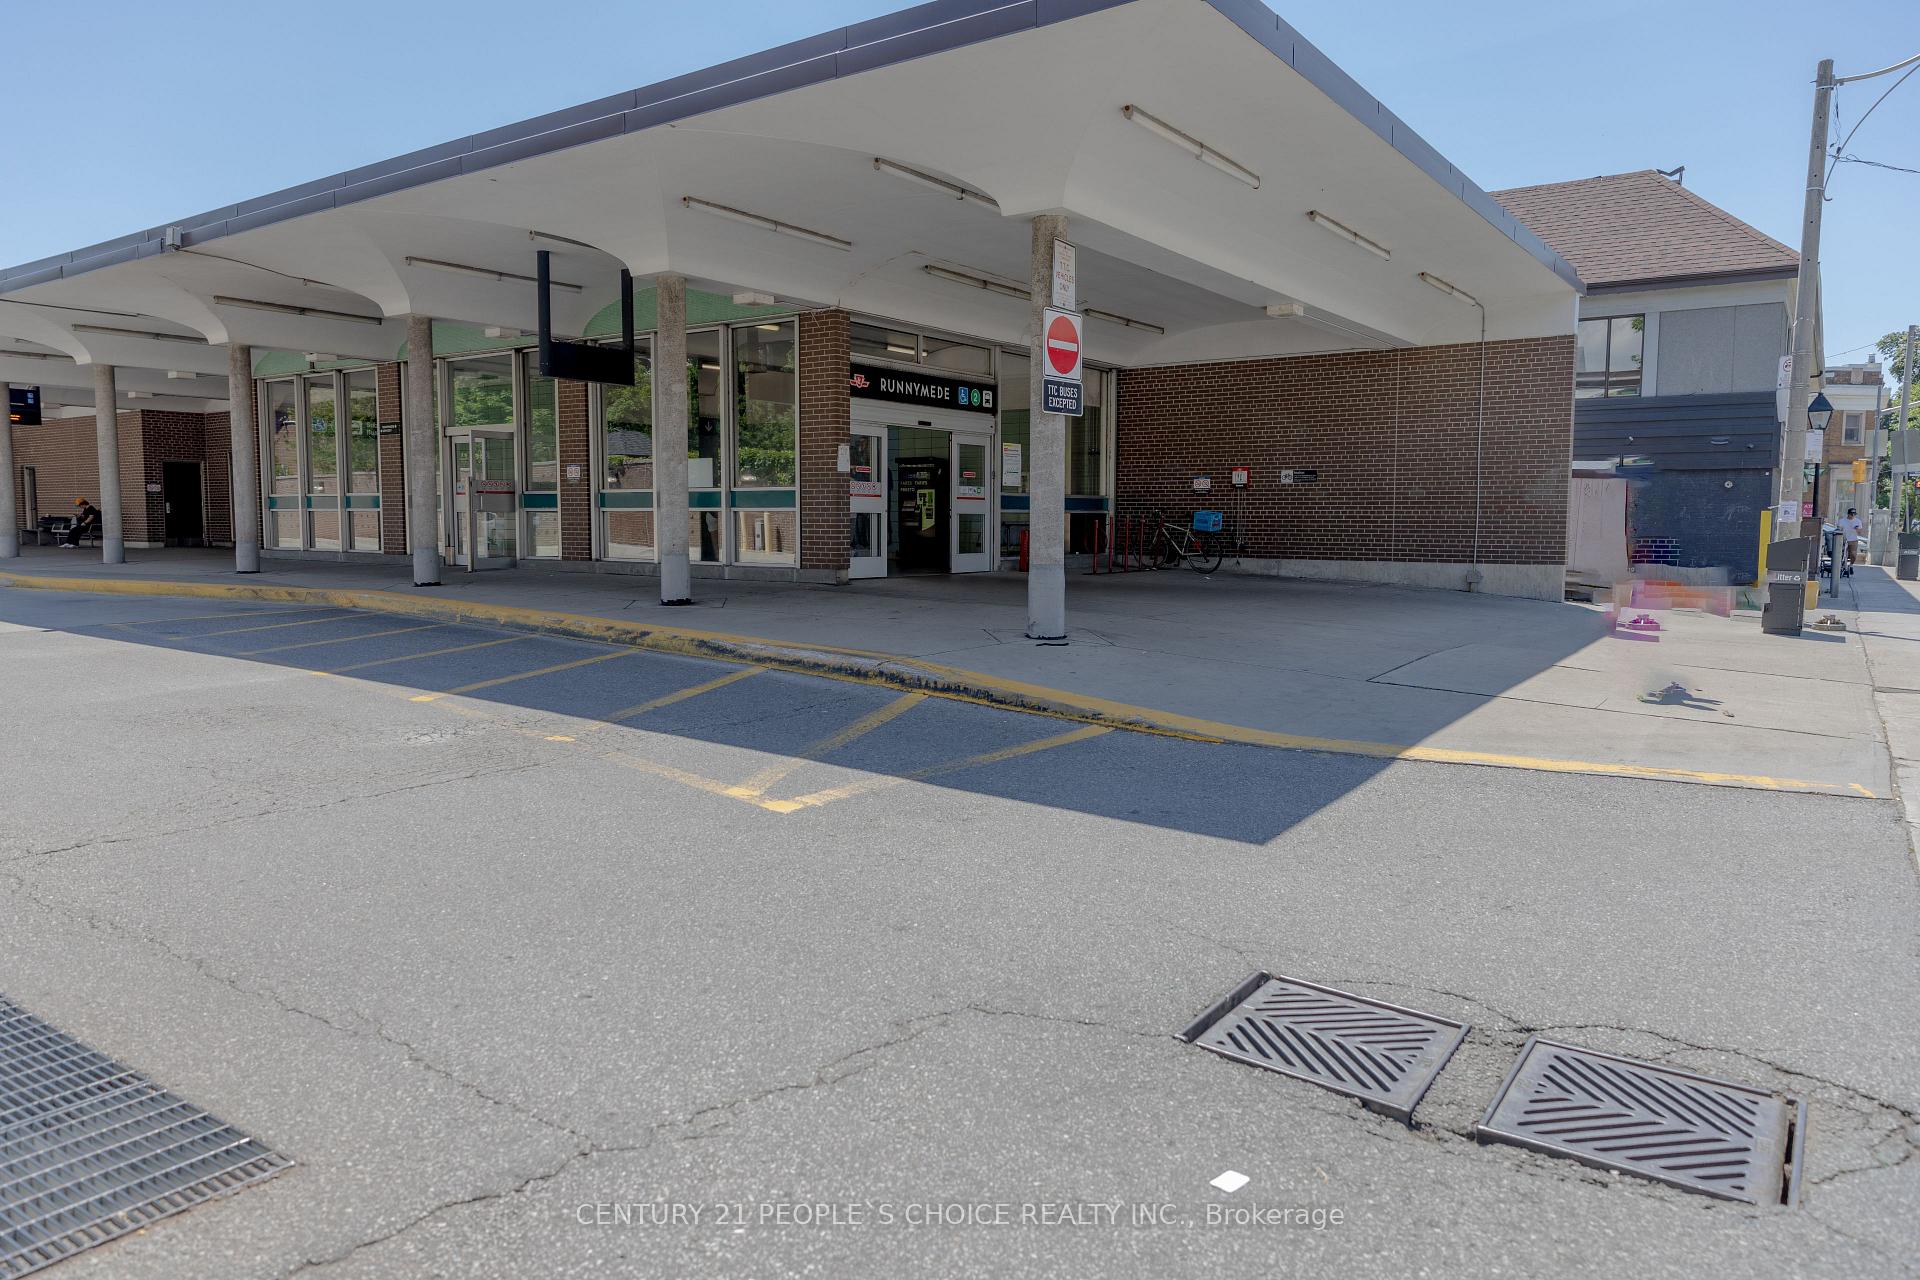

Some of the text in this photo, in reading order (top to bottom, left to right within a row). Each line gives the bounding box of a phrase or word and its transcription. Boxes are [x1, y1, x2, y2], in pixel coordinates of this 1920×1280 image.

[1059, 282, 1070, 293] ONLY
[880, 377, 950, 400] RUNNYMEDE
[1047, 384, 1078, 399] TTC BUSES
[1048, 396, 1077, 410] EXCEPTED
